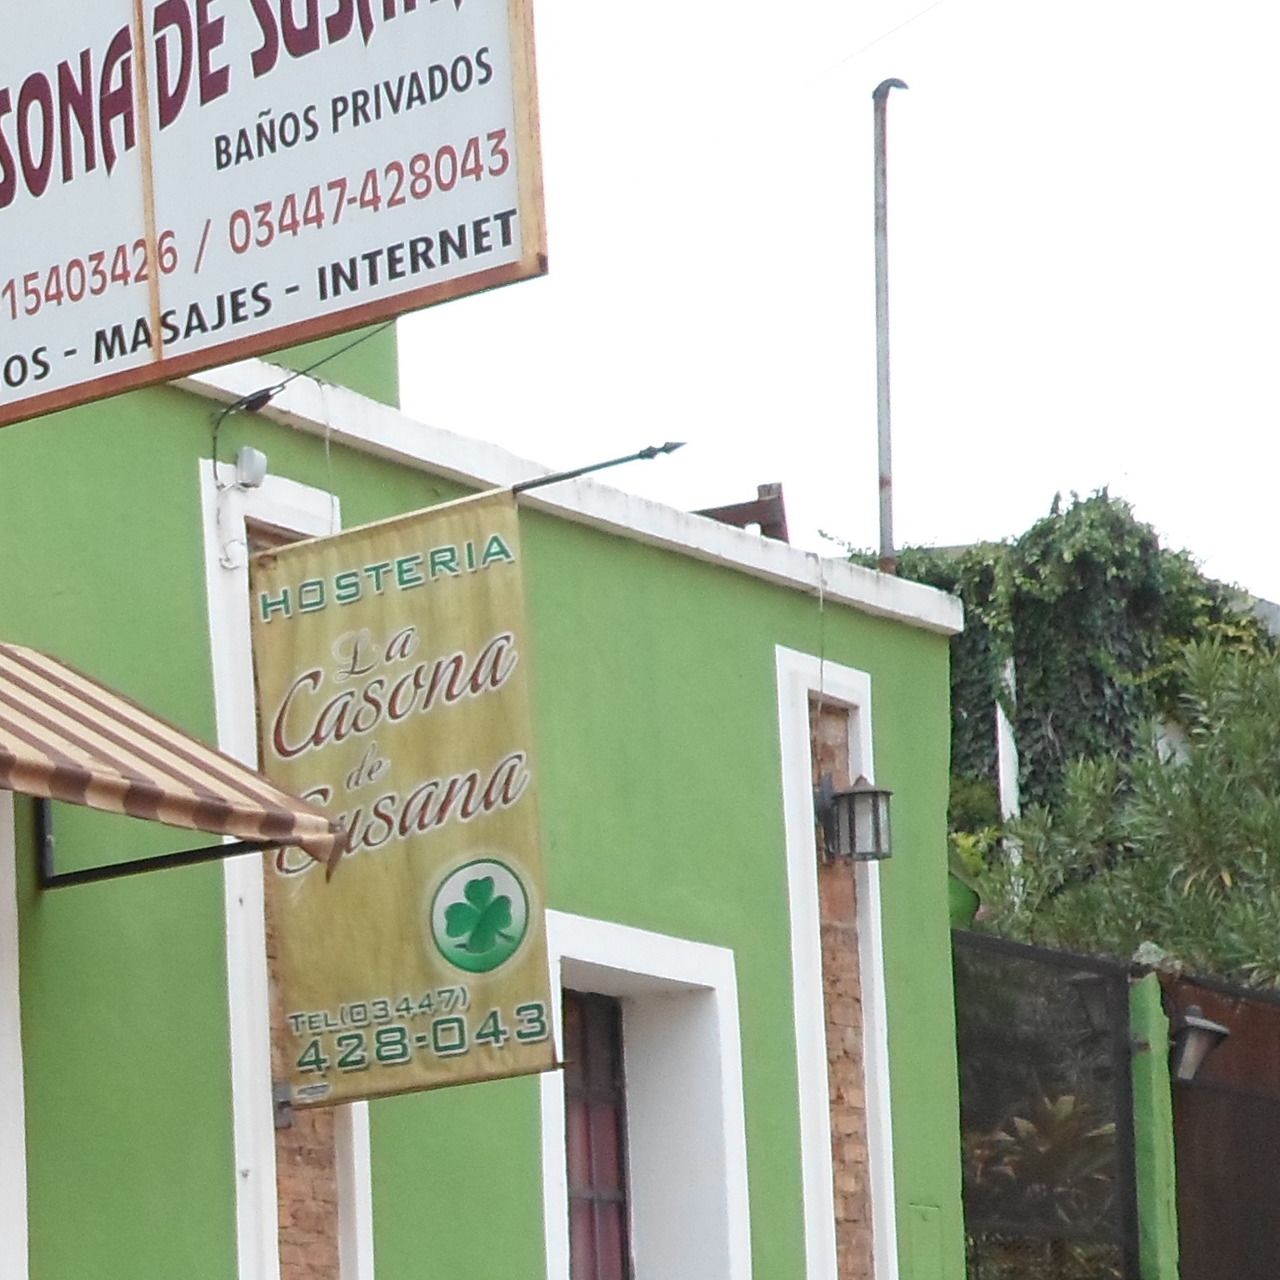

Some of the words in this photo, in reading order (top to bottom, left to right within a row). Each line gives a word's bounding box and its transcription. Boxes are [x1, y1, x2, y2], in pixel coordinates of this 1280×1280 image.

[153, 0, 230, 131] DE
[215, 105, 319, 170] BAÑOS
[332, 47, 493, 133] PRIVADOS
[229, 128, 510, 254] 03447-428043
[93, 282, 272, 364] MASAJES
[317, 208, 517, 300] INTERNET
[261, 535, 512, 621] HOSTERIA
[274, 635, 518, 757] Casona
[336, 628, 416, 677] La
[346, 743, 384, 790] de
[297, 1003, 547, 1073] 428-043
